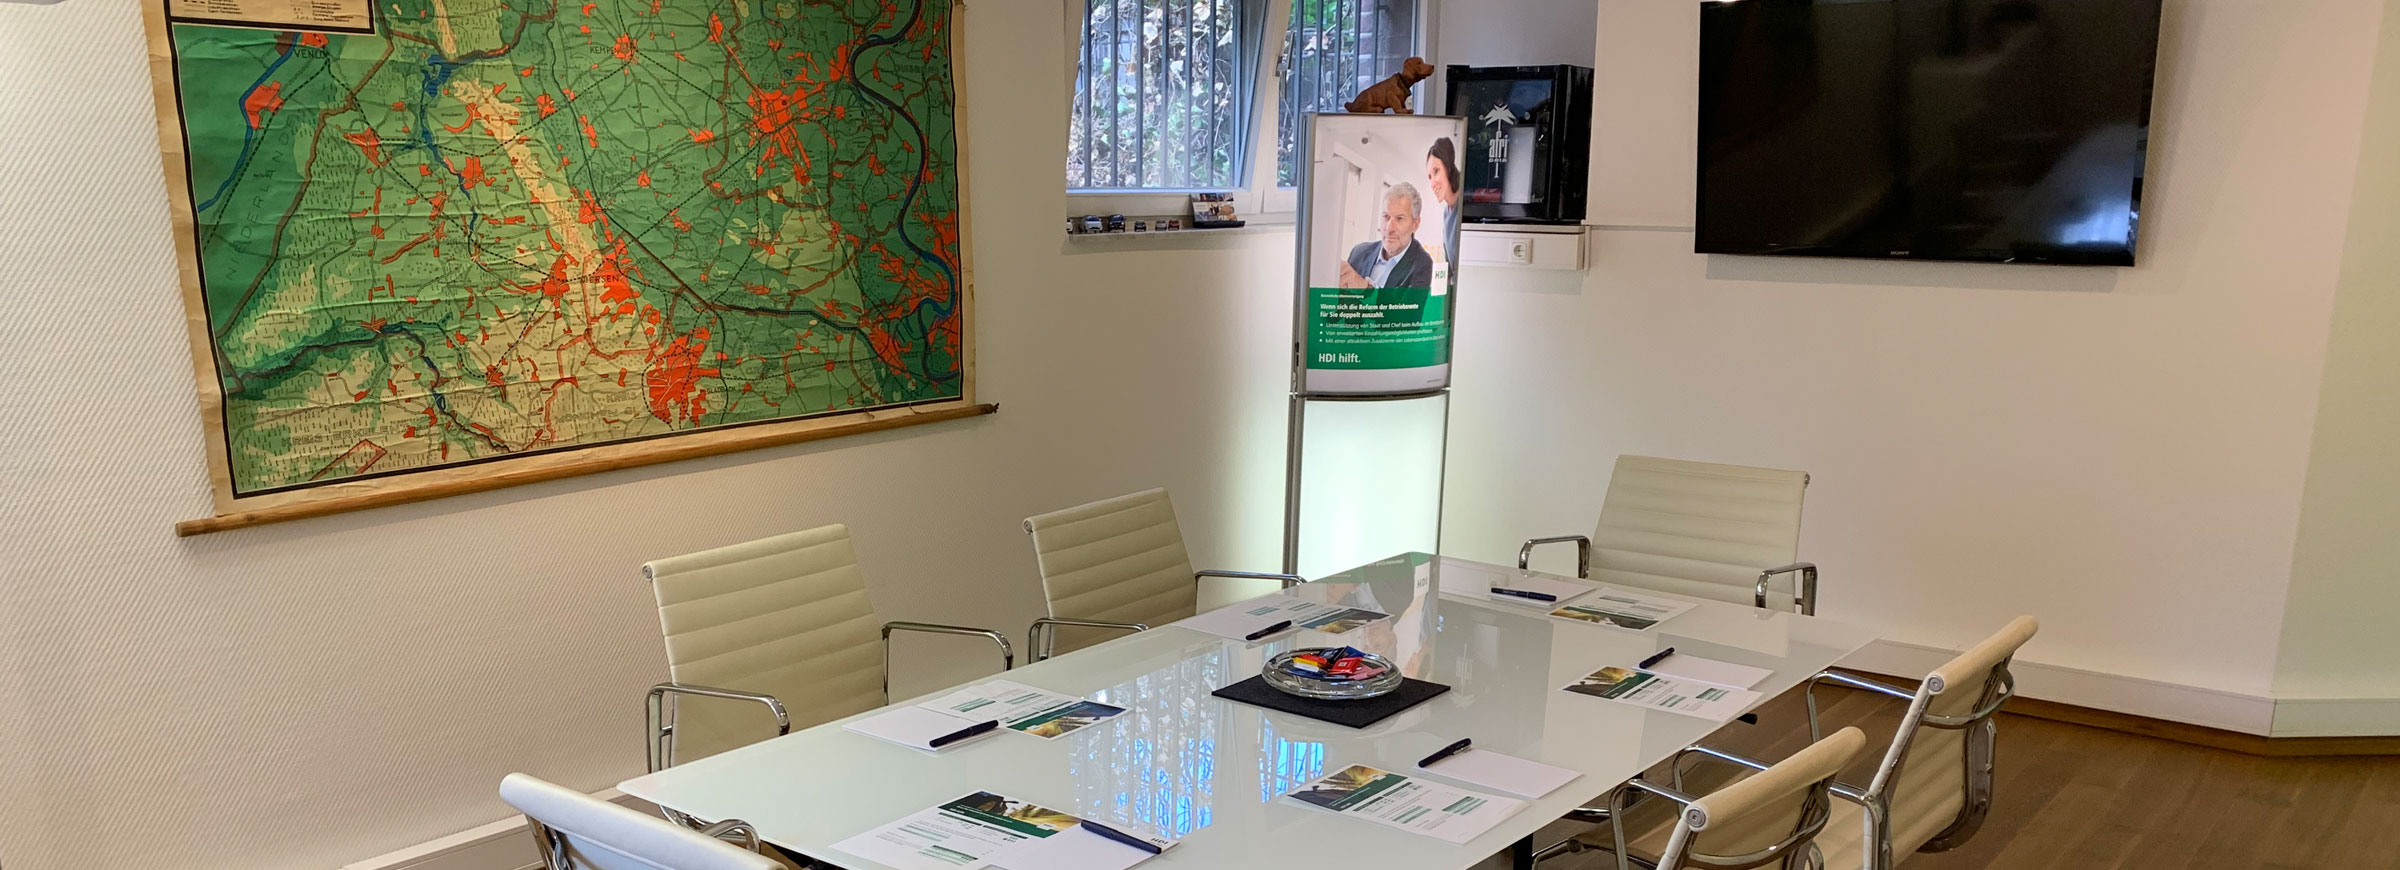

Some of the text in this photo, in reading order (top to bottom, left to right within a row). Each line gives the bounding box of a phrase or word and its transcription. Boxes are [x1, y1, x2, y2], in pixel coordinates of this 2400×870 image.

[294, 49, 328, 59] VENLO
[1489, 130, 1508, 158] afri
[1434, 270, 1446, 279] HDI
[1339, 311, 1361, 319] doppelt
[1318, 353, 1361, 363] HDI hilft.
